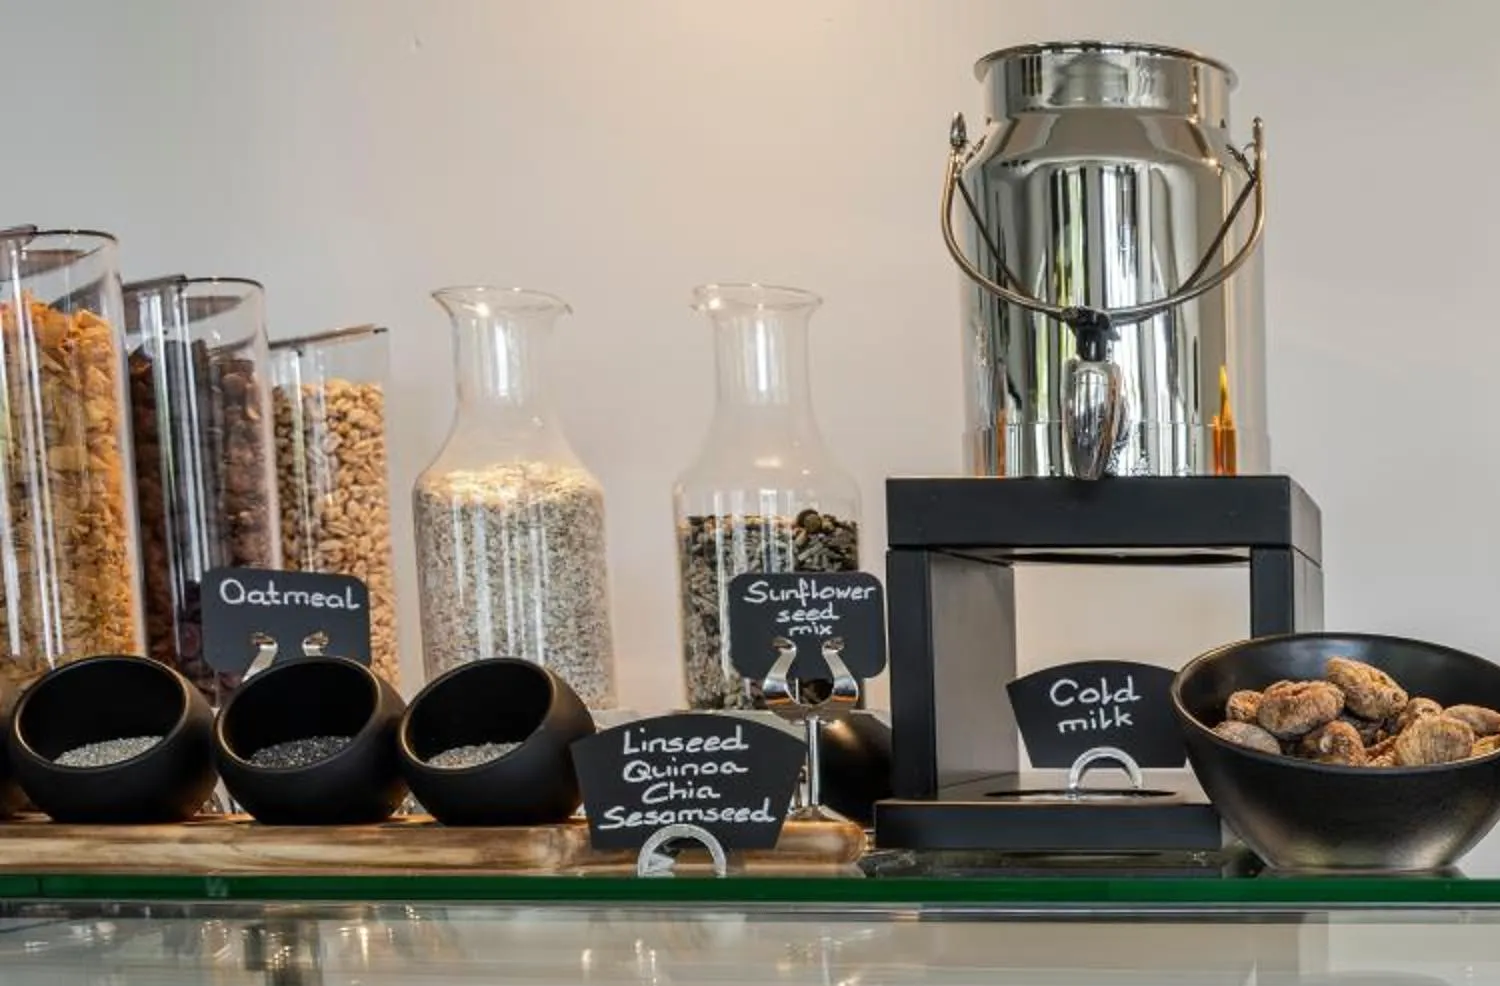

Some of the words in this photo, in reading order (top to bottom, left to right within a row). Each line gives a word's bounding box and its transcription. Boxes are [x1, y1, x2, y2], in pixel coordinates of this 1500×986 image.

[219, 578, 361, 610] Oatmeal
[743, 577, 877, 607] Sunflower
[776, 601, 840, 623] seed
[788, 622, 833, 637] mix
[1049, 675, 1143, 707] Cold
[1057, 706, 1134, 734] milk
[623, 724, 749, 755] Linseed
[622, 757, 749, 782] Quinoa
[641, 781, 721, 805] Chia
[598, 797, 777, 830] Sesamseed
